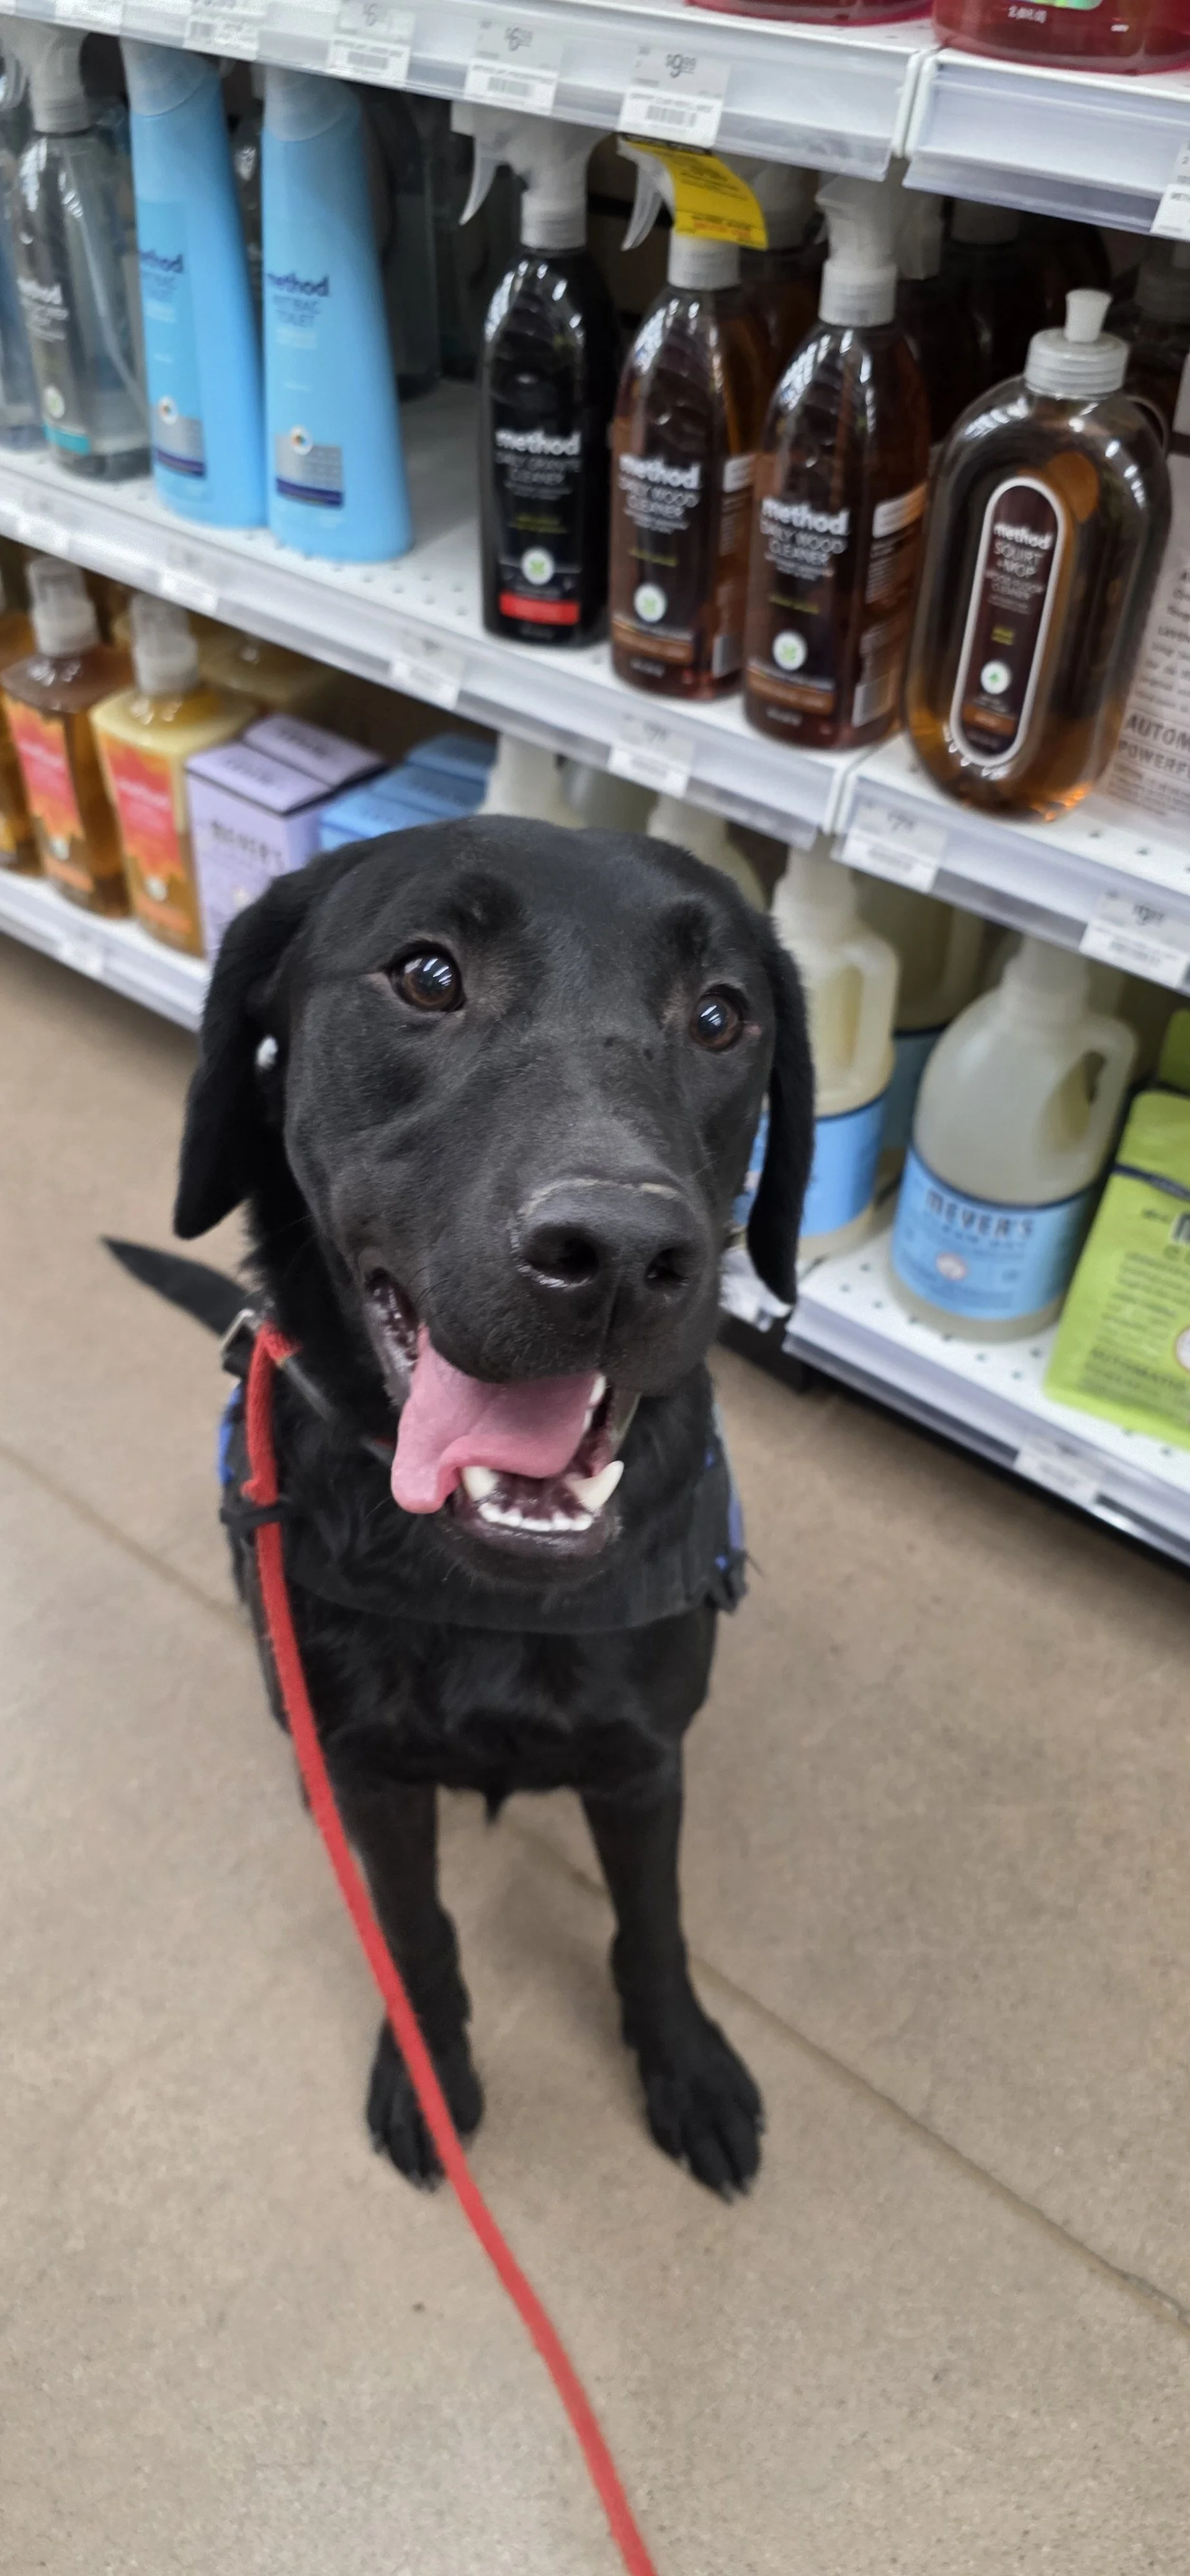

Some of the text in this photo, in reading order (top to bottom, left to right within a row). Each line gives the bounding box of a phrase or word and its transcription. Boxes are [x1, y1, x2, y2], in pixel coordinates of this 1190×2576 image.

[495, 428, 581, 456] method
[619, 453, 701, 489] method
[626, 494, 685, 518] CLEANER
[652, 486, 699, 508] WOOD
[762, 498, 850, 536] method
[760, 518, 847, 554] DAILY WOOD
[994, 523, 1053, 550] method
[768, 536, 830, 565] CLEANER
[994, 539, 1045, 565] SQUIRT
[925, 1188, 1034, 1238] MEYER'S
